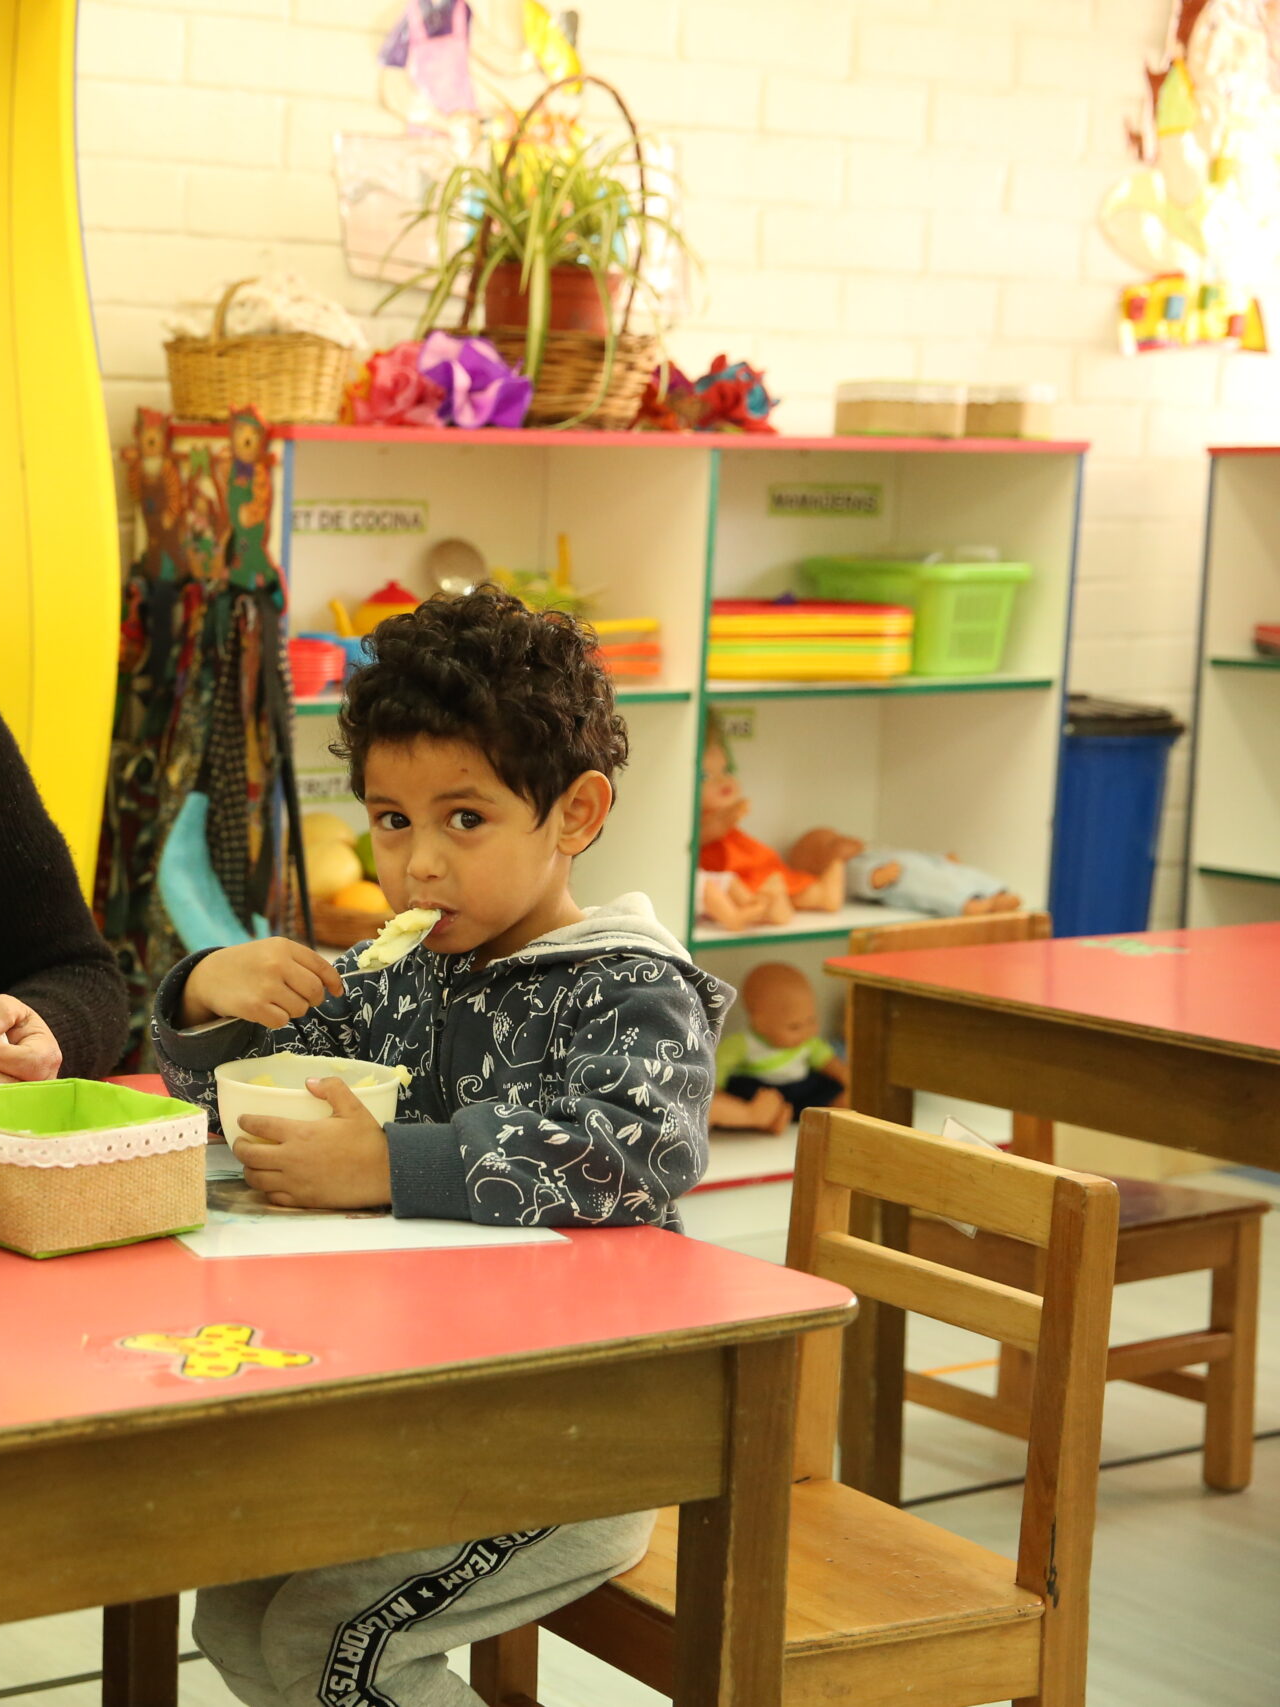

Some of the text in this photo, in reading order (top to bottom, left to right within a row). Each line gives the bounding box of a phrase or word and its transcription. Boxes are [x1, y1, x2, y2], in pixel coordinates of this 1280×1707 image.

[320, 509, 346, 531] DE
[349, 509, 424, 531] COCINA
[438, 1544, 498, 1591] TEAM
[329, 1623, 376, 1692] PORTS
